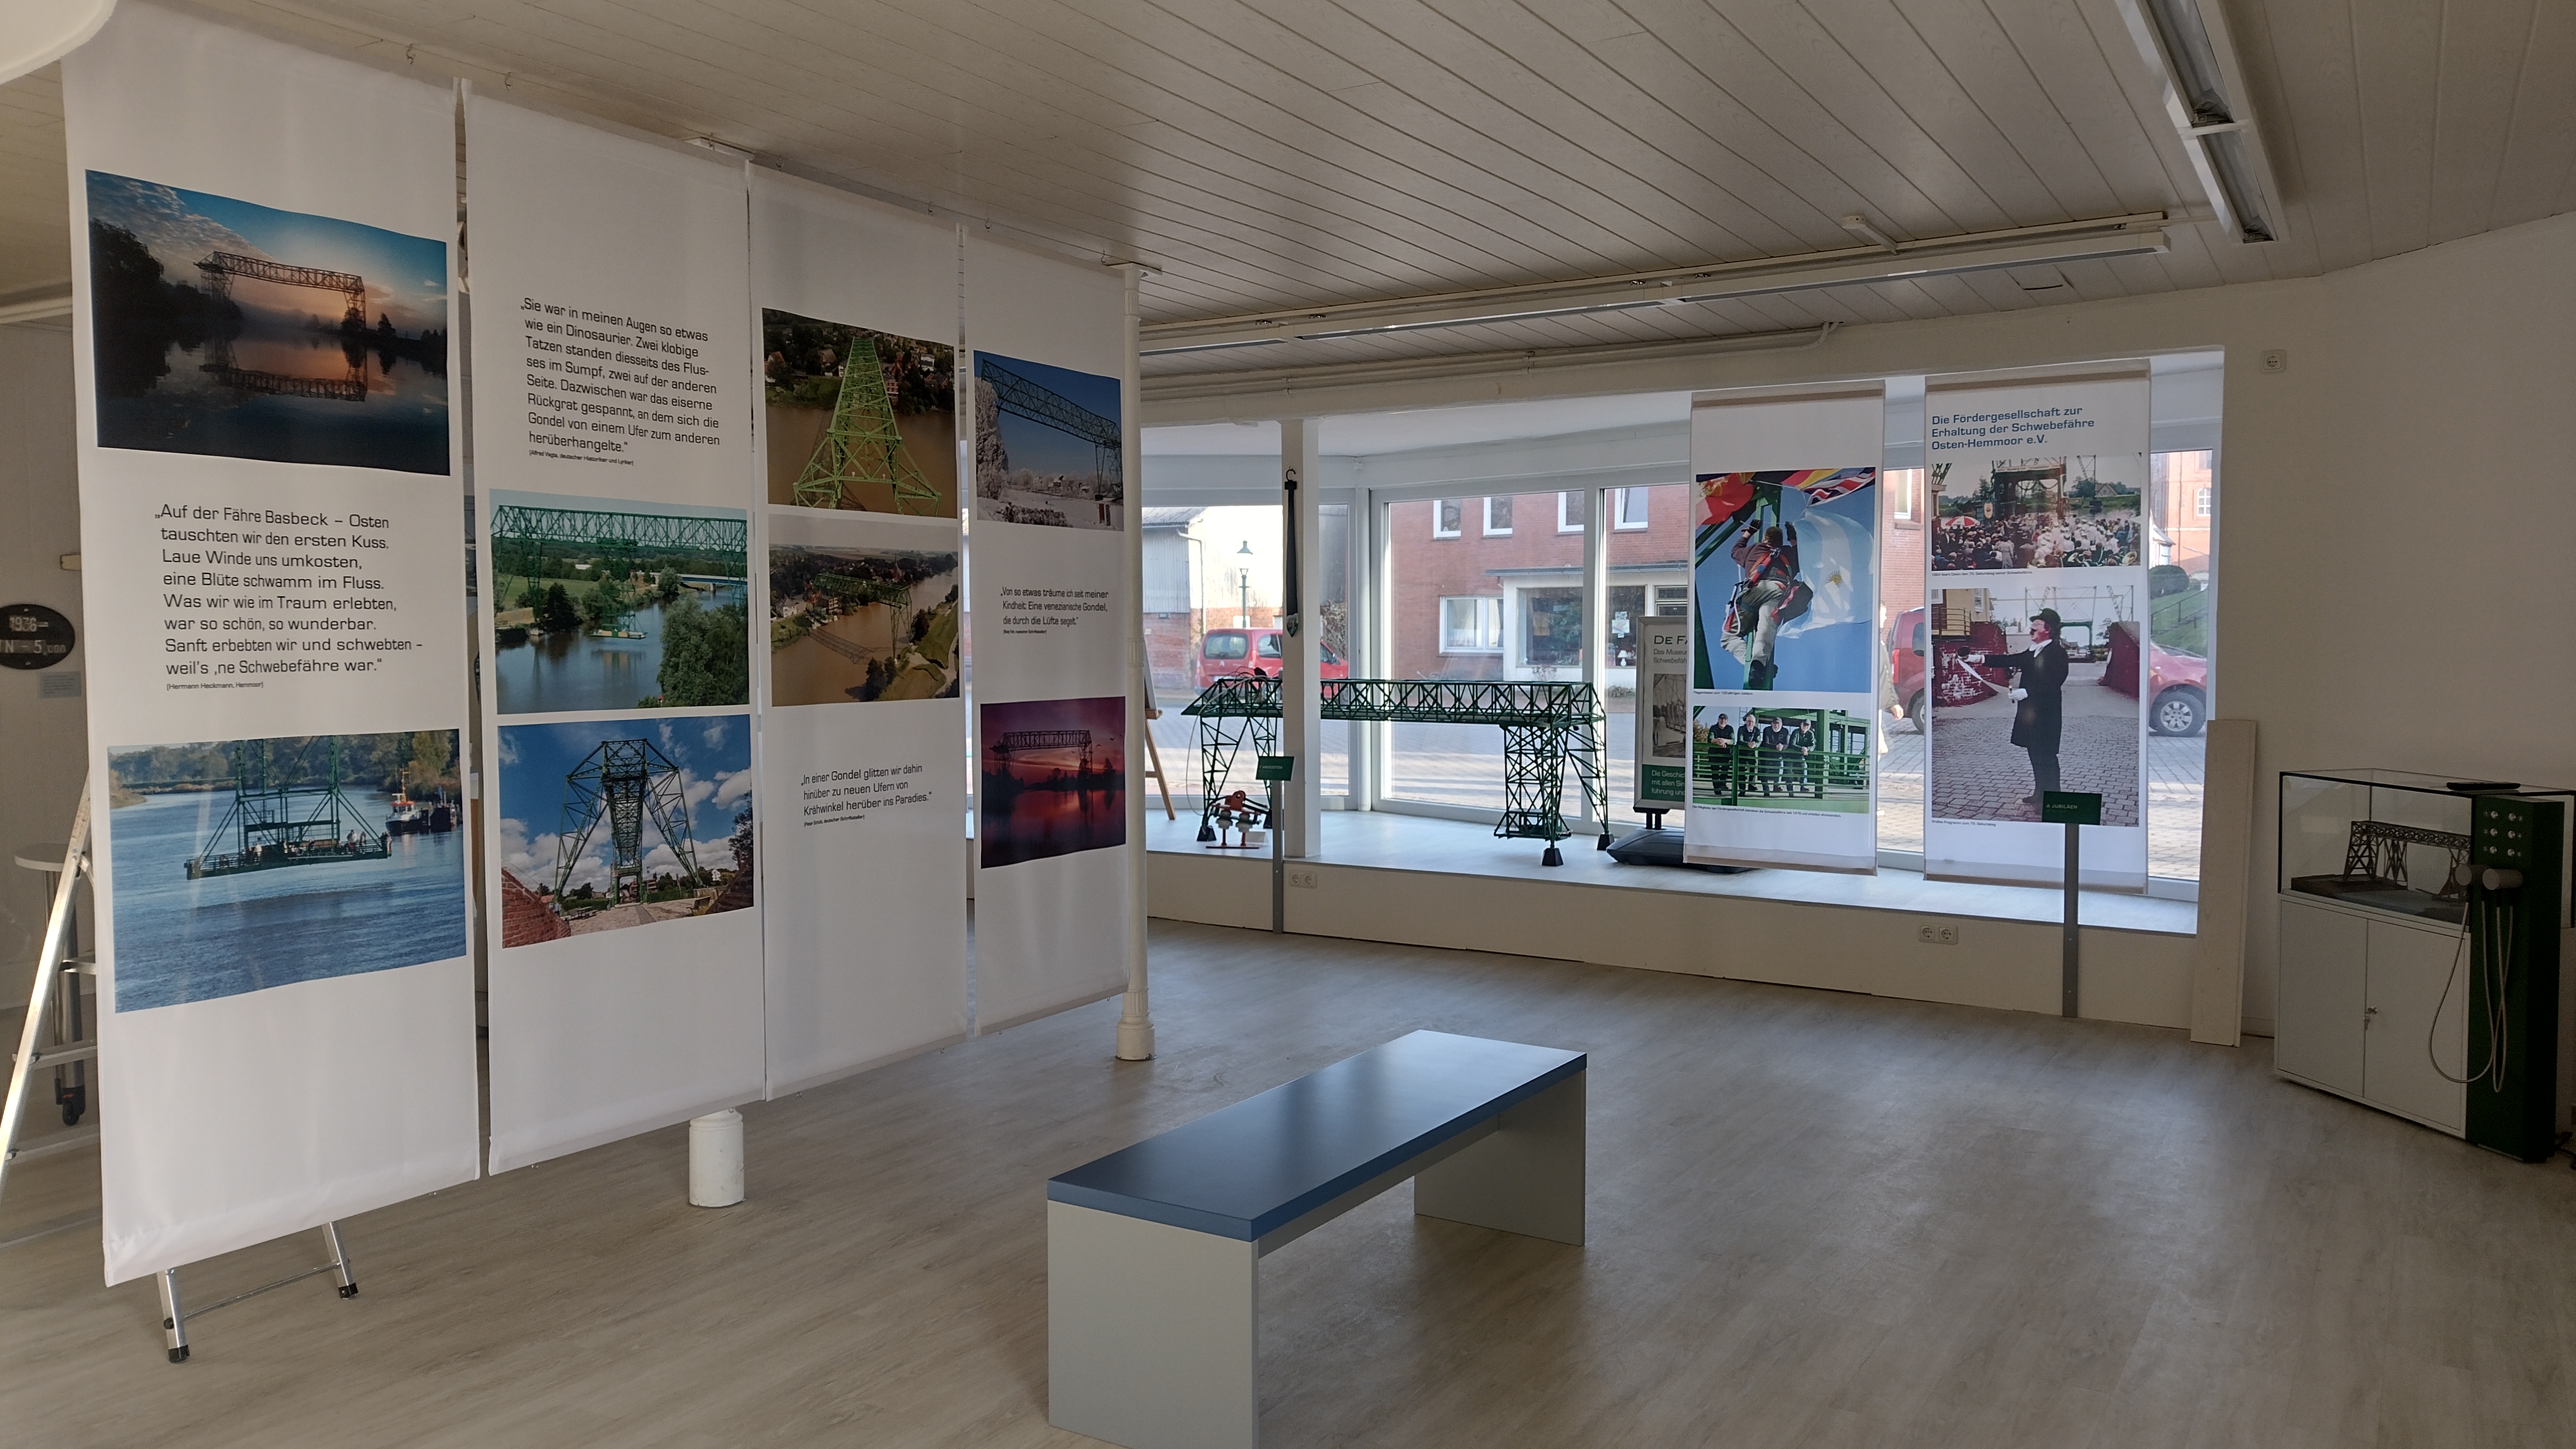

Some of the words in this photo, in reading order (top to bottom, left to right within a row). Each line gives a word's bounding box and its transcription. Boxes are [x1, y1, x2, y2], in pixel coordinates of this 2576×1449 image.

[544, 304, 566, 316] war
[569, 306, 579, 319] in
[581, 311, 623, 326] meinen
[626, 316, 657, 334] Augen
[660, 326, 672, 336] so
[675, 328, 708, 342] etwas
[524, 318, 543, 332] wie
[546, 321, 563, 335] ein
[566, 324, 633, 347] Dinosaurier.
[635, 335, 659, 351] Zwei
[661, 340, 699, 359] klobige
[525, 335, 562, 353] Tatzen
[565, 344, 612, 361] standen
[615, 351, 659, 369] diesseits
[661, 359, 680, 372] des
[683, 362, 709, 376] Flus-
[526, 357, 546, 369] ses
[549, 358, 562, 372] im
[565, 361, 605, 380] Sumpf,
[608, 370, 631, 382] zwei
[633, 373, 649, 385] auf
[651, 375, 669, 387] der
[671, 380, 717, 394] anderen
[527, 373, 557, 390] Seite.
[560, 378, 627, 399] Dazwischen
[629, 391, 648, 402] war
[650, 392, 669, 405] das
[671, 396, 713, 410] eiserne
[528, 392, 579, 412] Rückgrat
[581, 403, 635, 419] gespannt,
[637, 410, 649, 420] an
[651, 410, 674, 424] dem
[677, 414, 699, 427] sich
[703, 416, 719, 428] die
[1932, 415, 1950, 425] Die
[1953, 407, 2061, 424] Fördergesellschaft
[2063, 408, 2083, 416] zur
[528, 411, 565, 428] Gondel
[567, 420, 588, 430] von
[591, 420, 625, 434] einem
[628, 424, 649, 438] Ufer
[650, 430, 671, 441] zum
[674, 432, 720, 446] anderen
[1931, 427, 1986, 438] Erhaltung
[1989, 424, 2009, 434] der
[2011, 419, 2095, 432] Schwebefähre
[1931, 438, 2024, 450] Osten-Hemmoor
[2026, 434, 2047, 444] e.V.
[192, 505, 220, 520] der
[224, 507, 262, 523] Fähre
[265, 510, 329, 526] Basbeck
[349, 514, 389, 529] Osten
[160, 528, 238, 543] tauschten
[242, 531, 262, 544] wir
[265, 532, 289, 546] den
[294, 535, 347, 547] ersten
[352, 534, 389, 549] Kuss.
[162, 548, 201, 564] Laue
[205, 550, 252, 565] Winde
[255, 556, 278, 566] uns
[281, 554, 362, 570] umkosten,
[163, 571, 196, 586] eine
[201, 572, 239, 586] Blüte
[243, 574, 312, 588] schwamm
[318, 575, 337, 589] im
[343, 576, 384, 590] Fluss.
[163, 593, 202, 608] Was
[206, 594, 230, 608] wir
[233, 595, 255, 609] wie
[258, 595, 273, 609] im
[276, 595, 327, 609] Traum
[333, 596, 396, 612] erlebten,
[164, 619, 196, 630] war
[200, 619, 218, 630] so
[222, 617, 265, 632] schön,
[268, 620, 283, 630] so
[287, 617, 376, 630] wunderbar.
[165, 638, 208, 652] Sanft
[212, 638, 272, 652] erbebten
[275, 638, 297, 651] wir
[302, 638, 331, 651] und
[337, 638, 411, 651] schwebten
[1654, 635, 1673, 645] DE
[239, 659, 339, 674] Schwebefähre
[811, 773, 830, 784] einer
[831, 769, 861, 781] Gondel
[863, 768, 889, 781] glitten
[890, 767, 902, 776] wir
[903, 764, 922, 774] dahin
[803, 788, 831, 801] hinüber
[831, 788, 841, 797] zu
[844, 785, 871, 795] neuen
[873, 782, 895, 793] Ufern
[896, 782, 908, 790] von
[803, 801, 844, 816] Krähwinkel
[846, 798, 882, 811] herüber
[883, 798, 894, 807] ins
